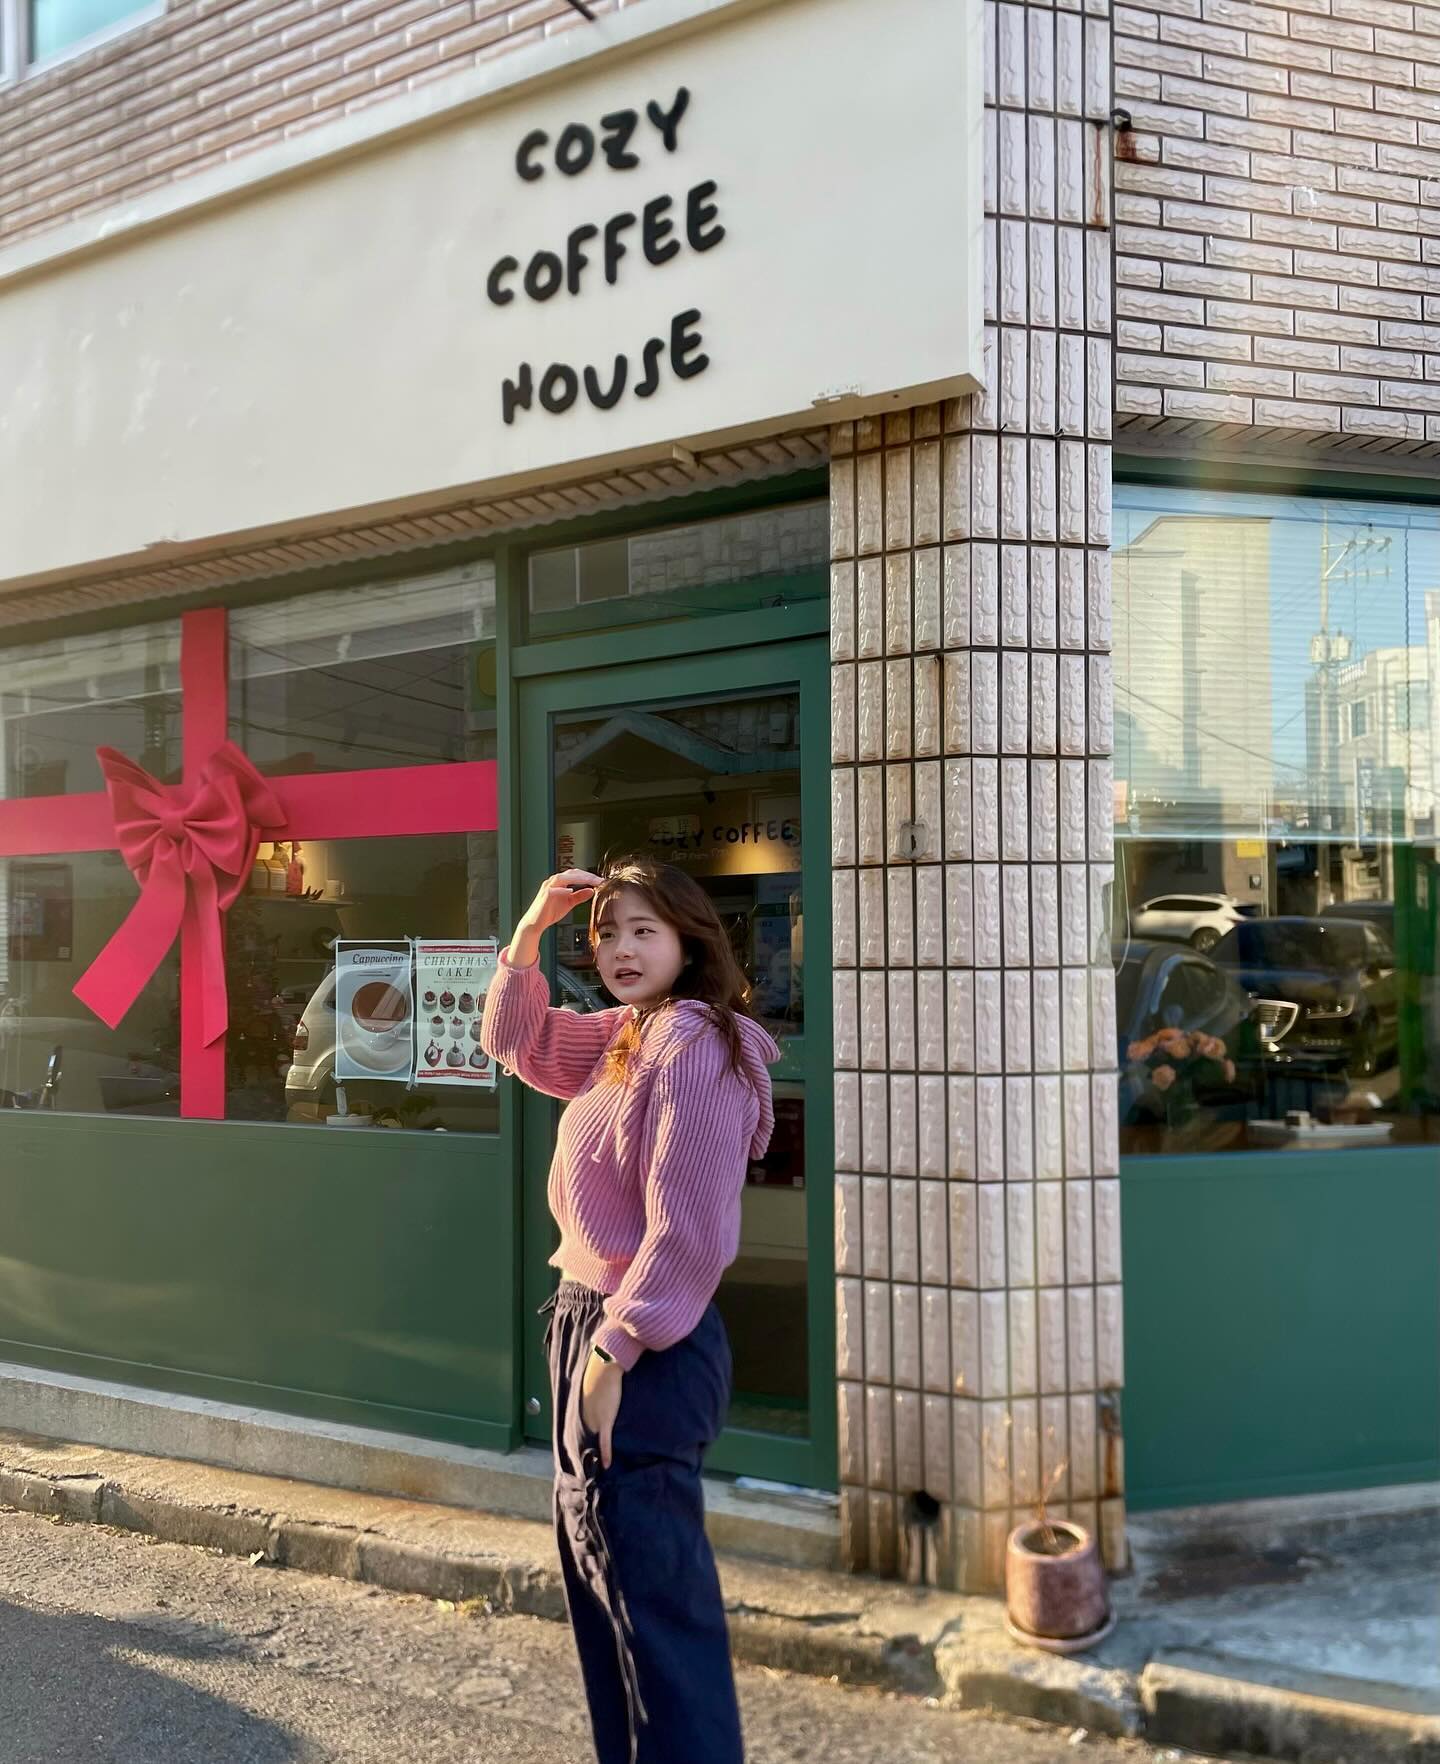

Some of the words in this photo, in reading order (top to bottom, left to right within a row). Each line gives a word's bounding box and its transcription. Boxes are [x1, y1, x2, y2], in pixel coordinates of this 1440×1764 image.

[515, 86, 690, 182] COZY
[486, 179, 726, 306] COFFEE
[501, 308, 710, 425] HOUSE
[712, 819, 794, 844] COFFEE
[352, 953, 404, 965] Cappuccino
[424, 956, 489, 967] CHRISTMAS
[437, 967, 473, 977] CAKE
